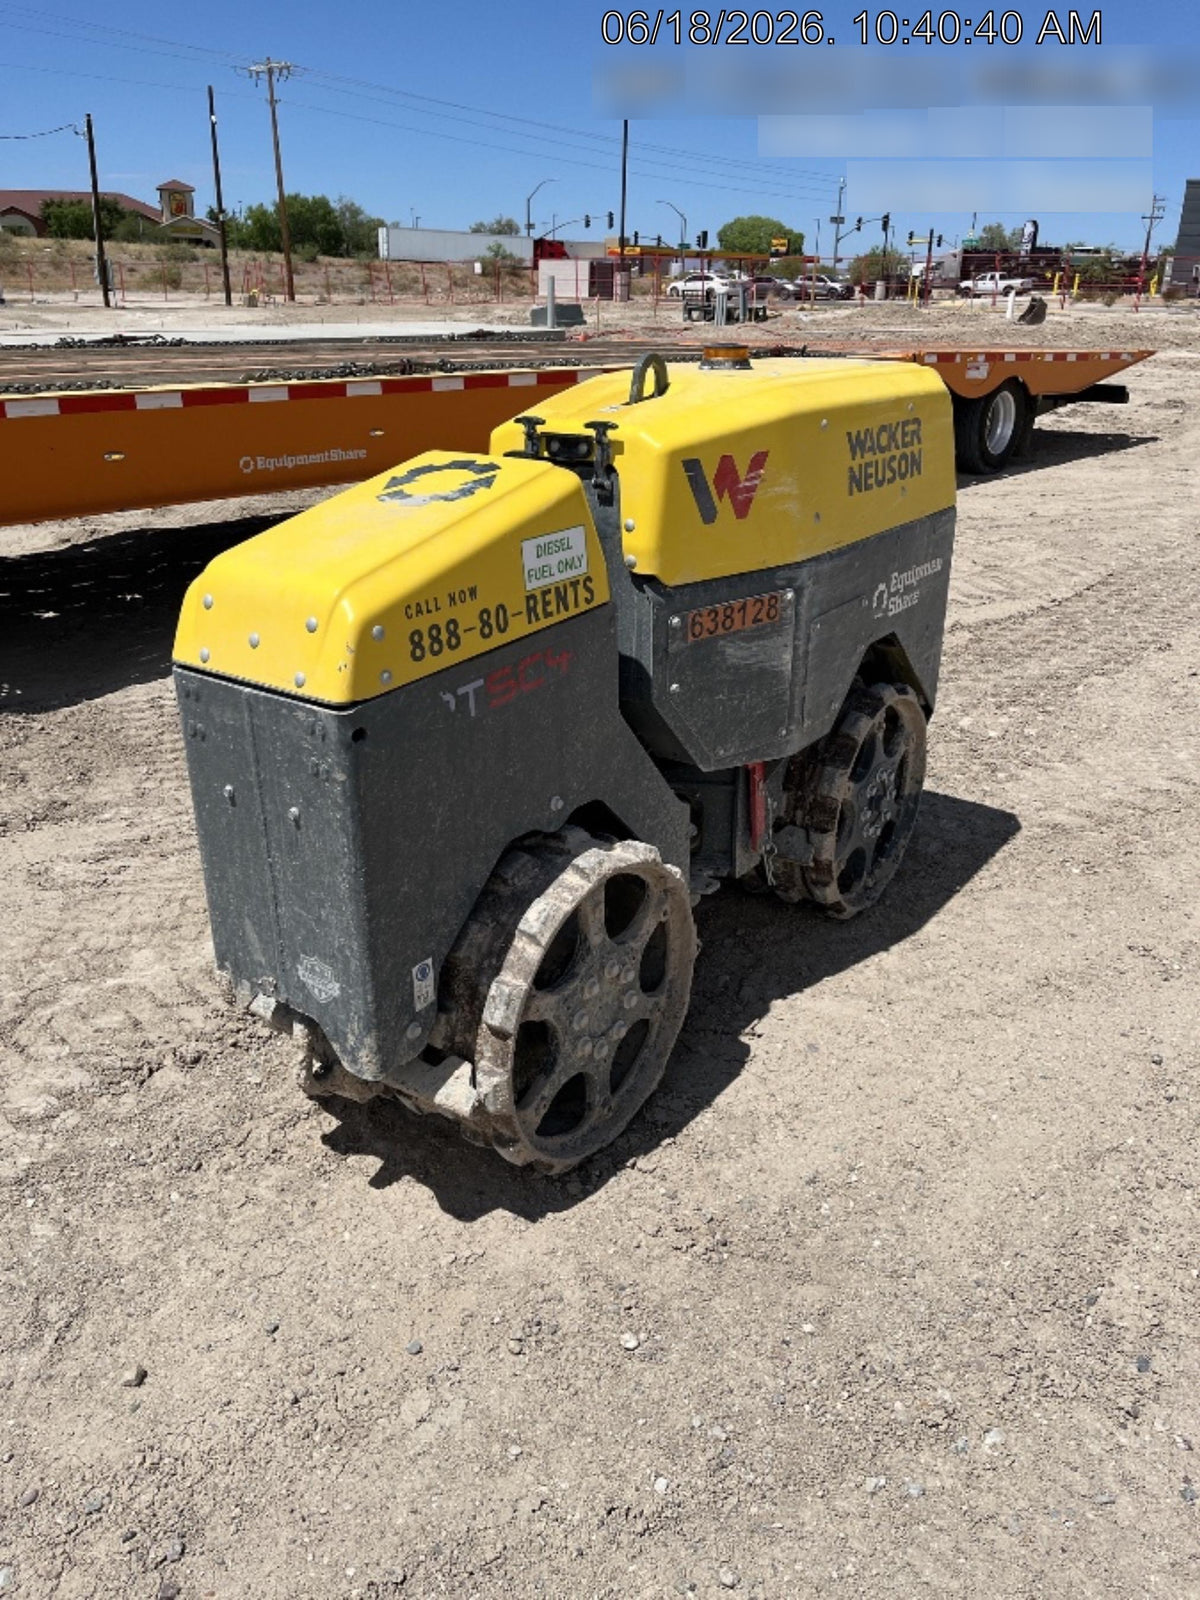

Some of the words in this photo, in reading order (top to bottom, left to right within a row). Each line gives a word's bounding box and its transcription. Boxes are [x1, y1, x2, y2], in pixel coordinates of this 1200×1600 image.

[846, 417, 922, 461] WACKER
[256, 448, 367, 471] EquipmentShare
[848, 448, 923, 496] NEUSON
[535, 536, 574, 559] DIESEL
[527, 561, 555, 584] FUEL
[557, 554, 585, 575] ONLY
[404, 596, 442, 620] CALL
[448, 585, 479, 607] NOW
[408, 575, 595, 663] 888-80-RENTS
[690, 594, 779, 640] 638128
[887, 589, 920, 617] Share
